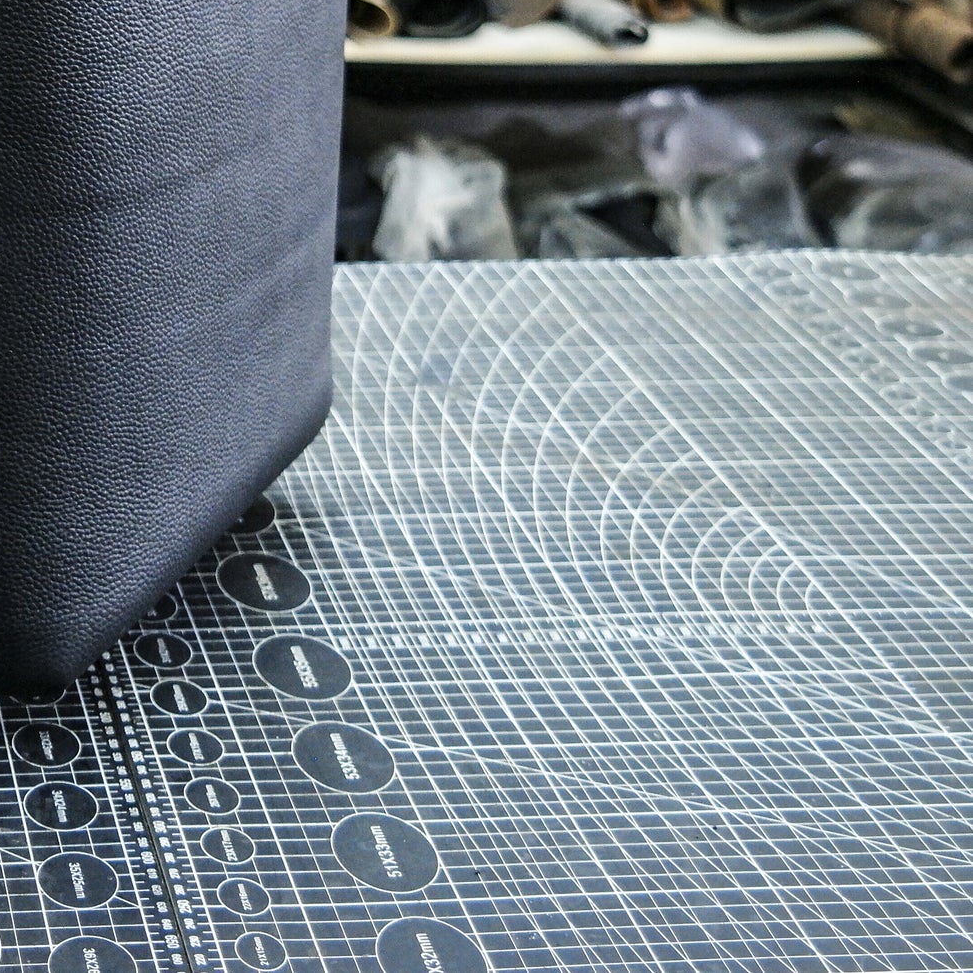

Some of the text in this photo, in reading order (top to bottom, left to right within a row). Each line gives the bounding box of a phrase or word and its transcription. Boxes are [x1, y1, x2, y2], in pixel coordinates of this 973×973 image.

[330, 733, 360, 780] 53X34mm
[51, 789, 68, 823] 34X24mm
[220, 829, 238, 862] 23X17mm
[370, 825, 403, 878] 51X33mm
[141, 852, 155, 864] 600
[169, 869, 180, 879] 270
[68, 862, 86, 899] 35X25mm
[174, 885, 185, 895] 260
[237, 883, 253, 911] 22X16mm
[157, 902, 168, 912] 630
[177, 900, 192, 913] 250
[162, 919, 173, 930] 640
[184, 918, 196, 929] 240
[165, 935, 179, 948] 650
[189, 936, 201, 947] 230
[253, 936, 269, 966] 21X15mm
[172, 954, 183, 964] 660
[194, 954, 207, 965] 220
